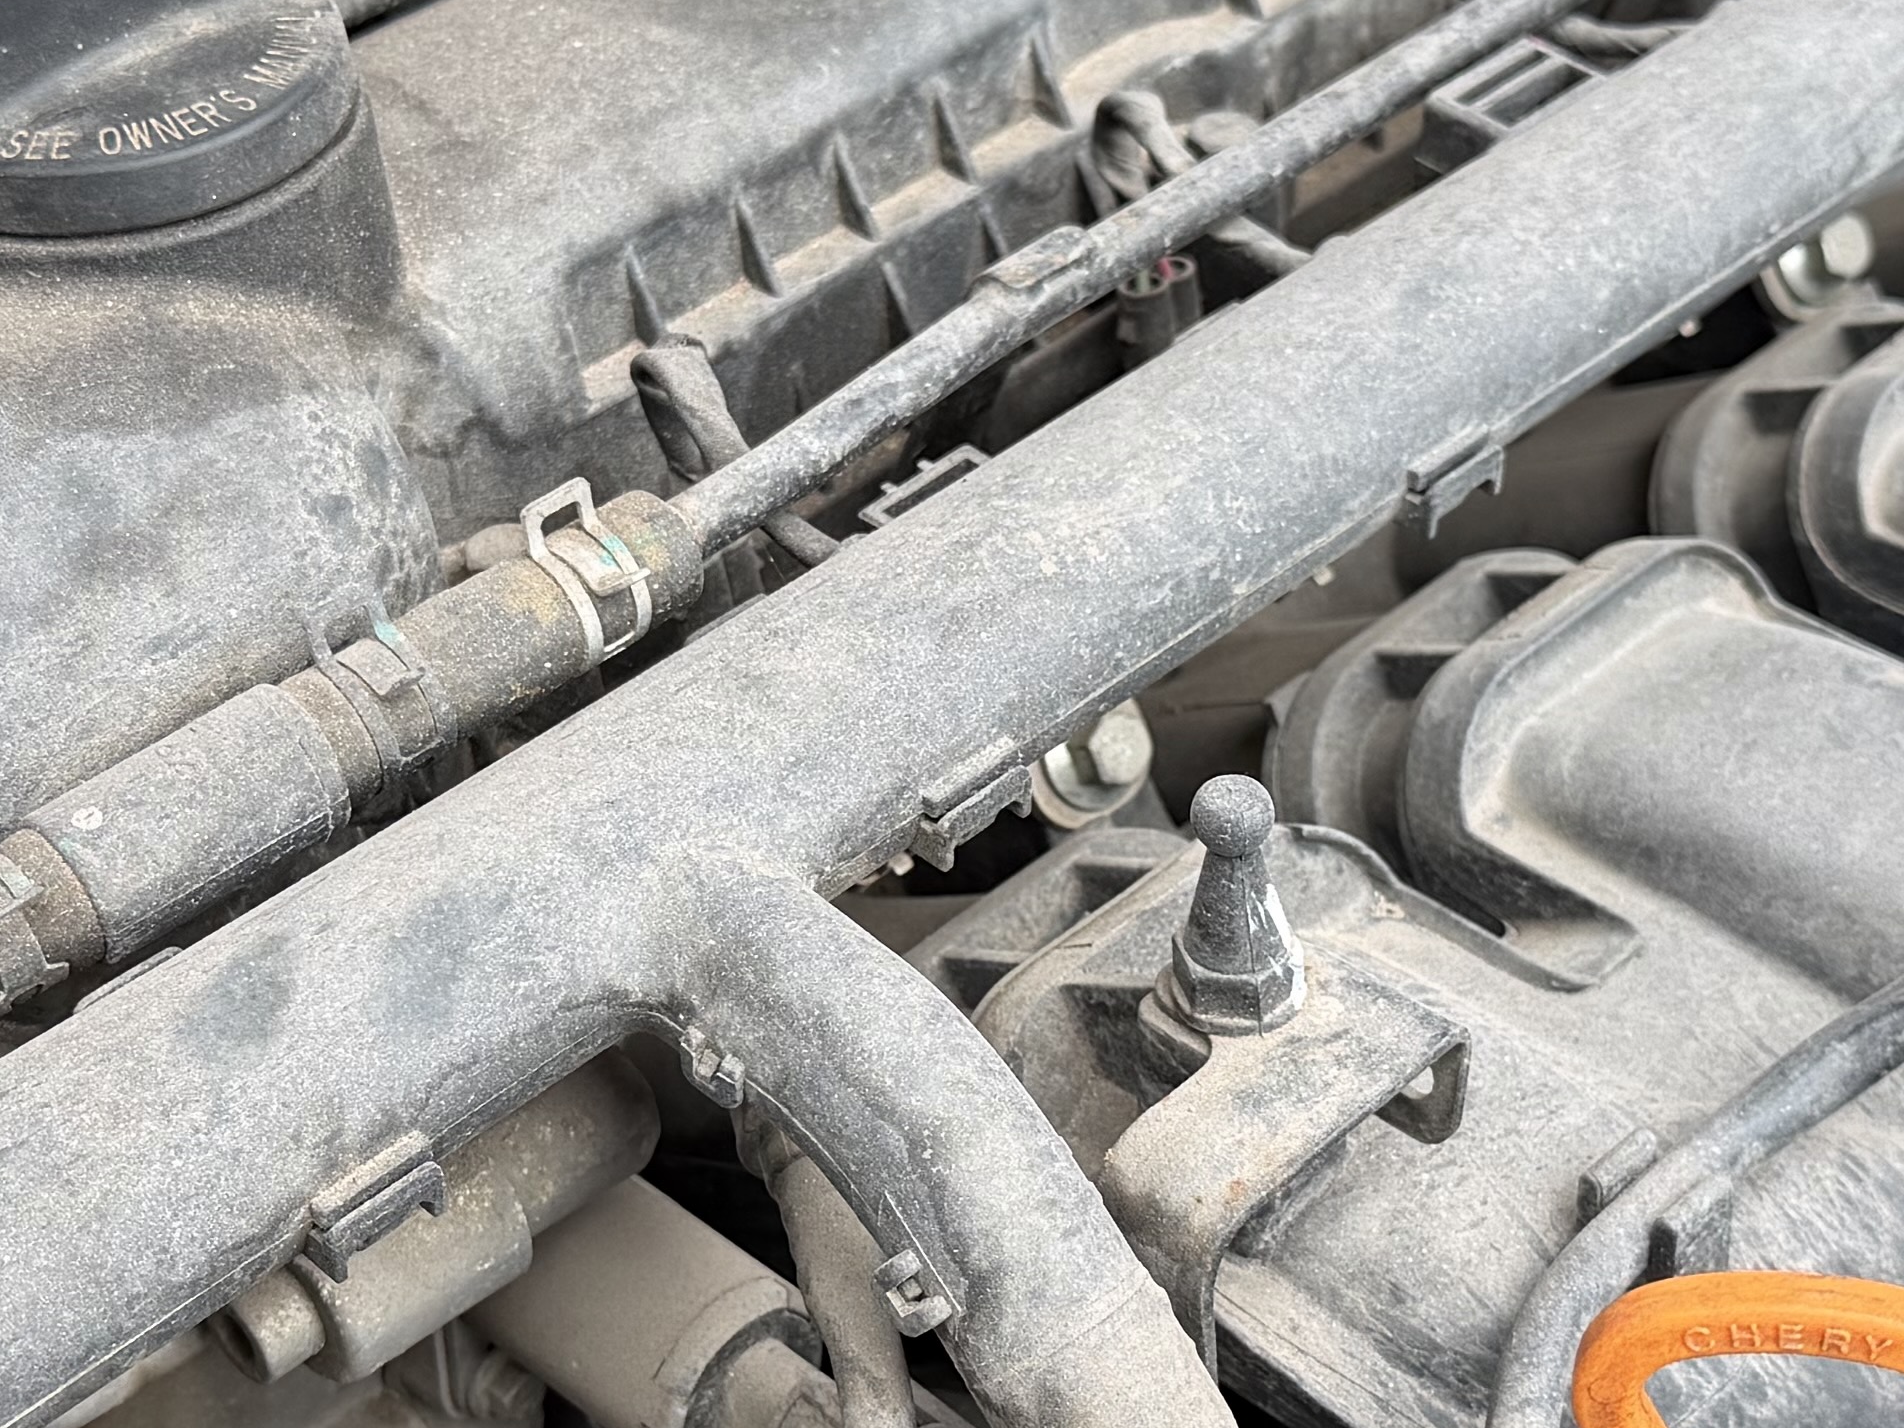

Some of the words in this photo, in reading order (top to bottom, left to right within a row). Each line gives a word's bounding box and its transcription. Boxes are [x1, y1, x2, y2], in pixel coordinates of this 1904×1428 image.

[0, 128, 80, 160] SEE
[98, 88, 257, 155] OWNER'S
[1683, 1322, 1894, 1361] CHERY
